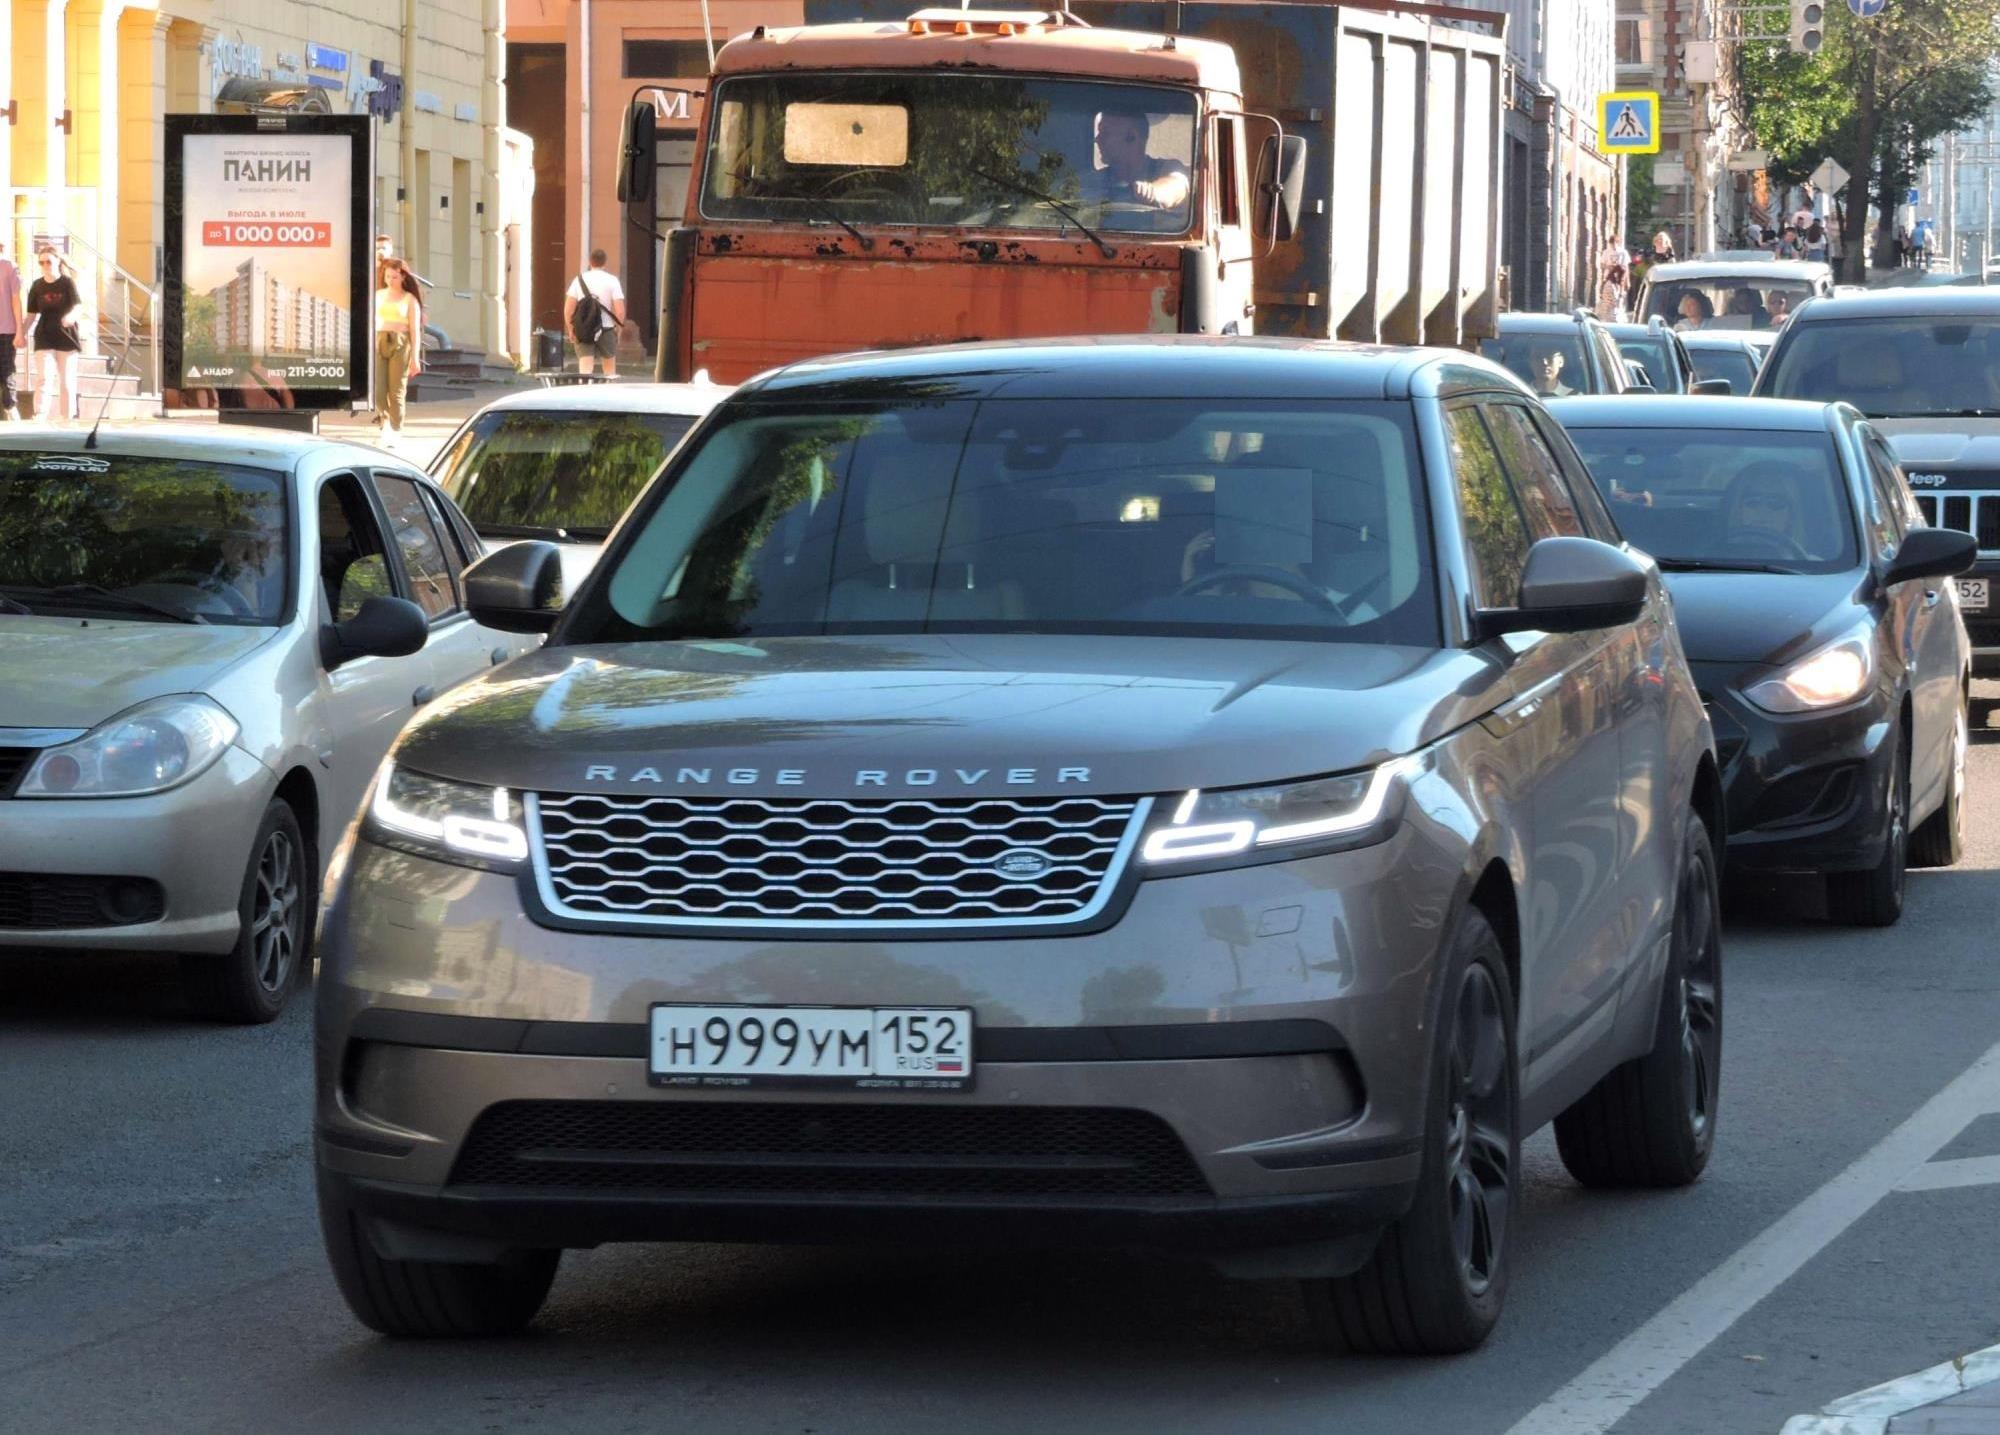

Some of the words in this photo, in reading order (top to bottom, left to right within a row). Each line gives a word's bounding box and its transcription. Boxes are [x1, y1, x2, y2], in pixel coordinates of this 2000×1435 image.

[224, 160, 311, 182] ПАНИН
[227, 210, 266, 218] ВЫГОДА
[270, 210, 276, 218] В
[279, 211, 306, 219] ИЮЛЕ
[235, 226, 273, 242] 000
[277, 226, 315, 243] 000
[203, 368, 234, 377] АНДОР
[1906, 472, 1947, 487] Jeep
[585, 764, 807, 787] RANGE
[855, 764, 1092, 787] ROVER
[882, 1015, 957, 1055] 152
[896, 1056, 934, 1071] RUS
